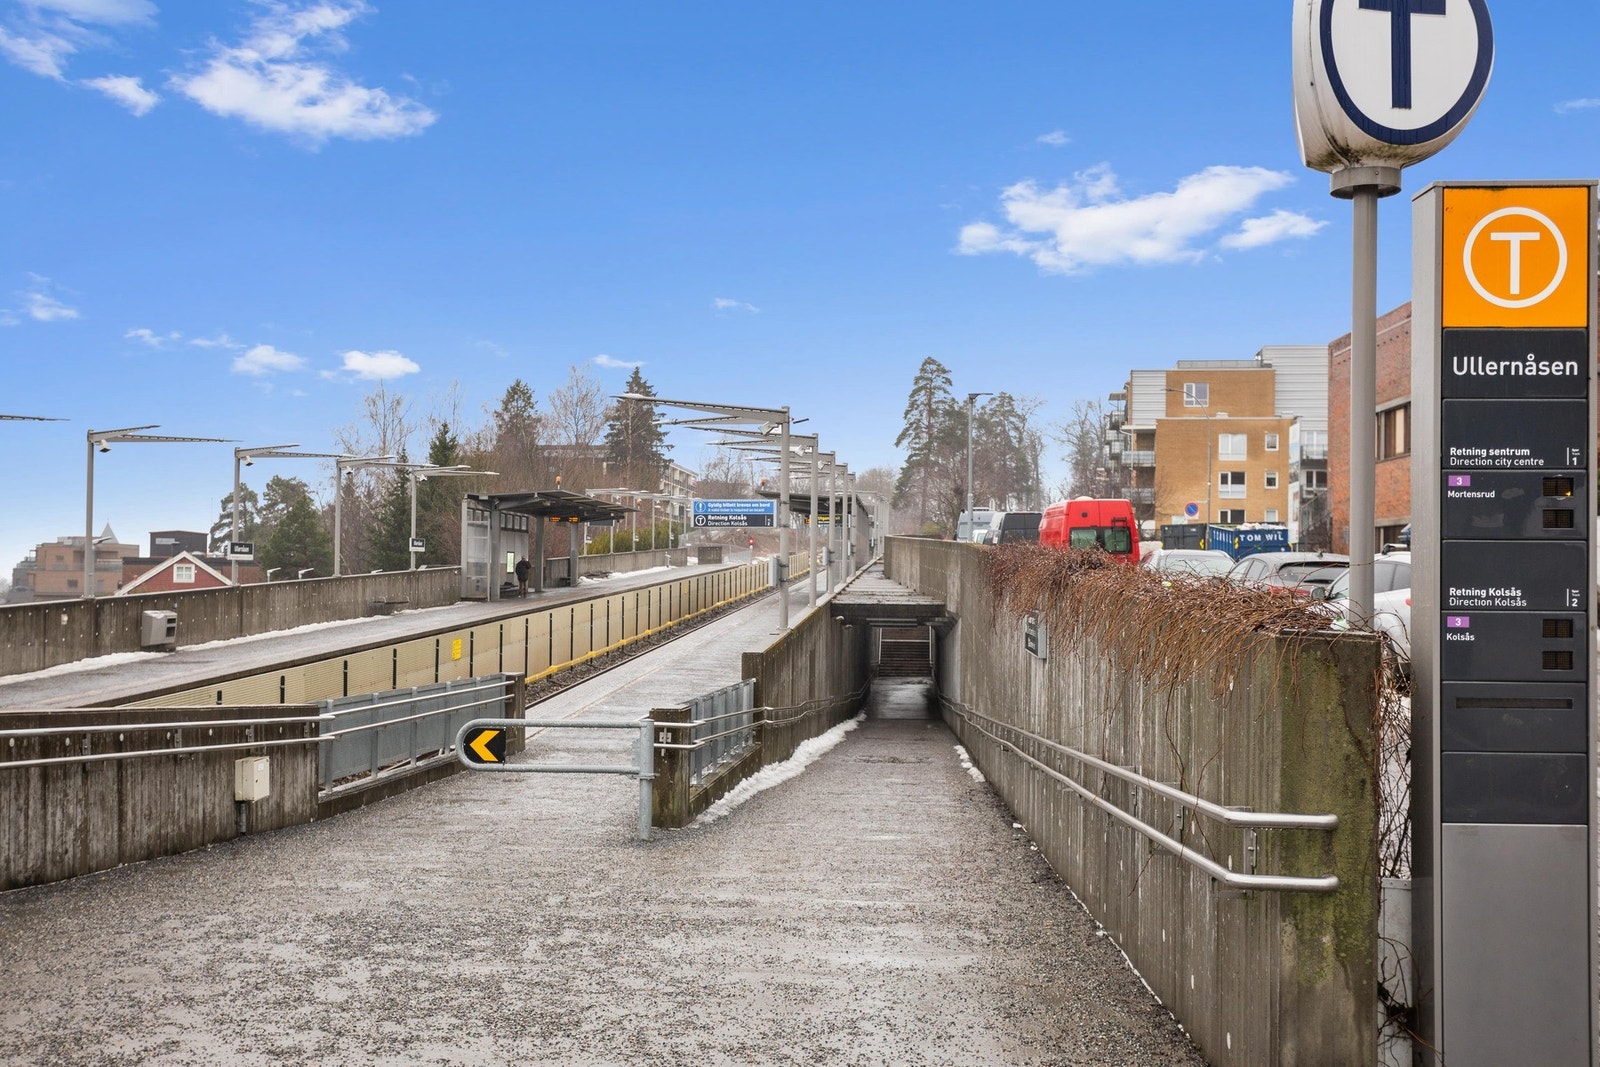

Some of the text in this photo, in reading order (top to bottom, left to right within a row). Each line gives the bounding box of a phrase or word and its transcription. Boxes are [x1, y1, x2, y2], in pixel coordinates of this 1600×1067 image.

[1490, 232, 1540, 295] T
[1453, 353, 1578, 376] Ullernåsen
[1449, 447, 1530, 458] Retning sentrum
[1450, 457, 1545, 468] Direction city centre
[1572, 457, 1578, 466] 1
[1456, 477, 1463, 486] 3
[1447, 490, 1496, 498] Mortensrud
[1239, 533, 1284, 542] TOM WIL
[1449, 586, 1522, 598] Retning Kolsås
[1449, 597, 1527, 607] Direction Kolsås
[1572, 598, 1578, 607] 2
[1455, 618, 1462, 627] 3
[1446, 632, 1475, 641] Kolsås
